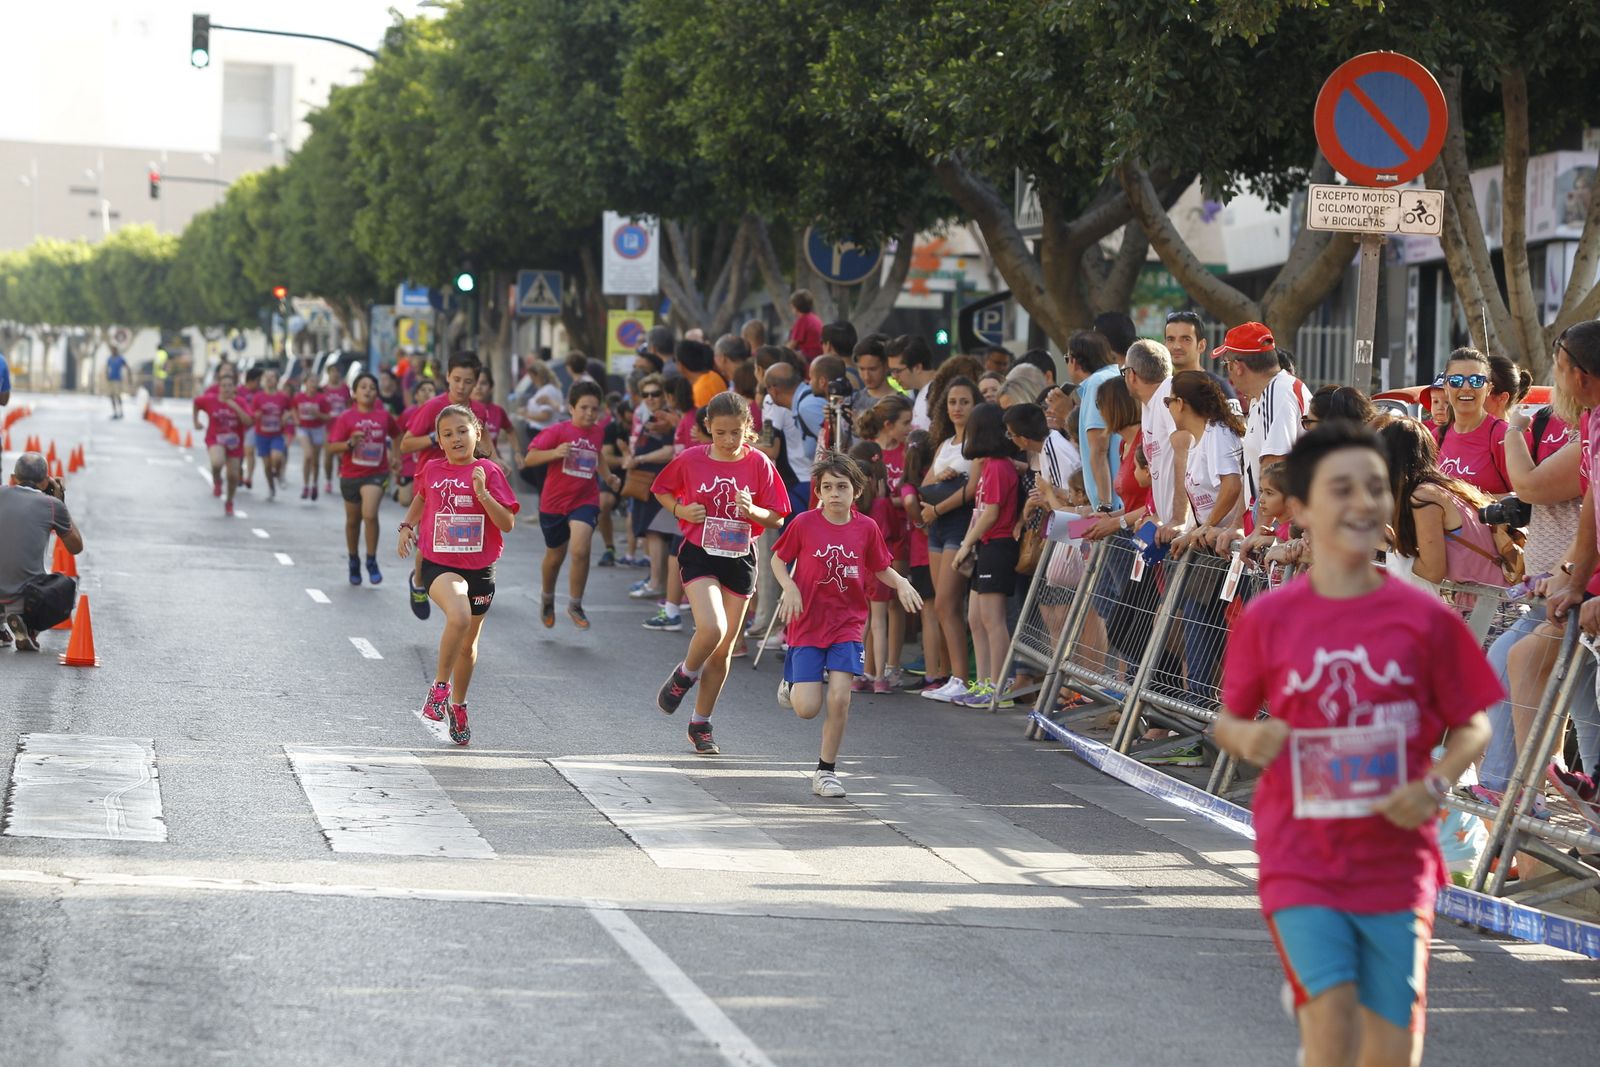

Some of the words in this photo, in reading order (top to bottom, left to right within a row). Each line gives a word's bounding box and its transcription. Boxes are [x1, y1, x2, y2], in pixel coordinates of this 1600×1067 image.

[1316, 190, 1360, 202] EXCEPTO
[1362, 193, 1396, 203] MOTOS
[1318, 203, 1391, 215] CICLOMOTORE
[1323, 216, 1330, 225] Y
[1332, 216, 1386, 228] BICICLETAS
[982, 310, 1001, 332] P
